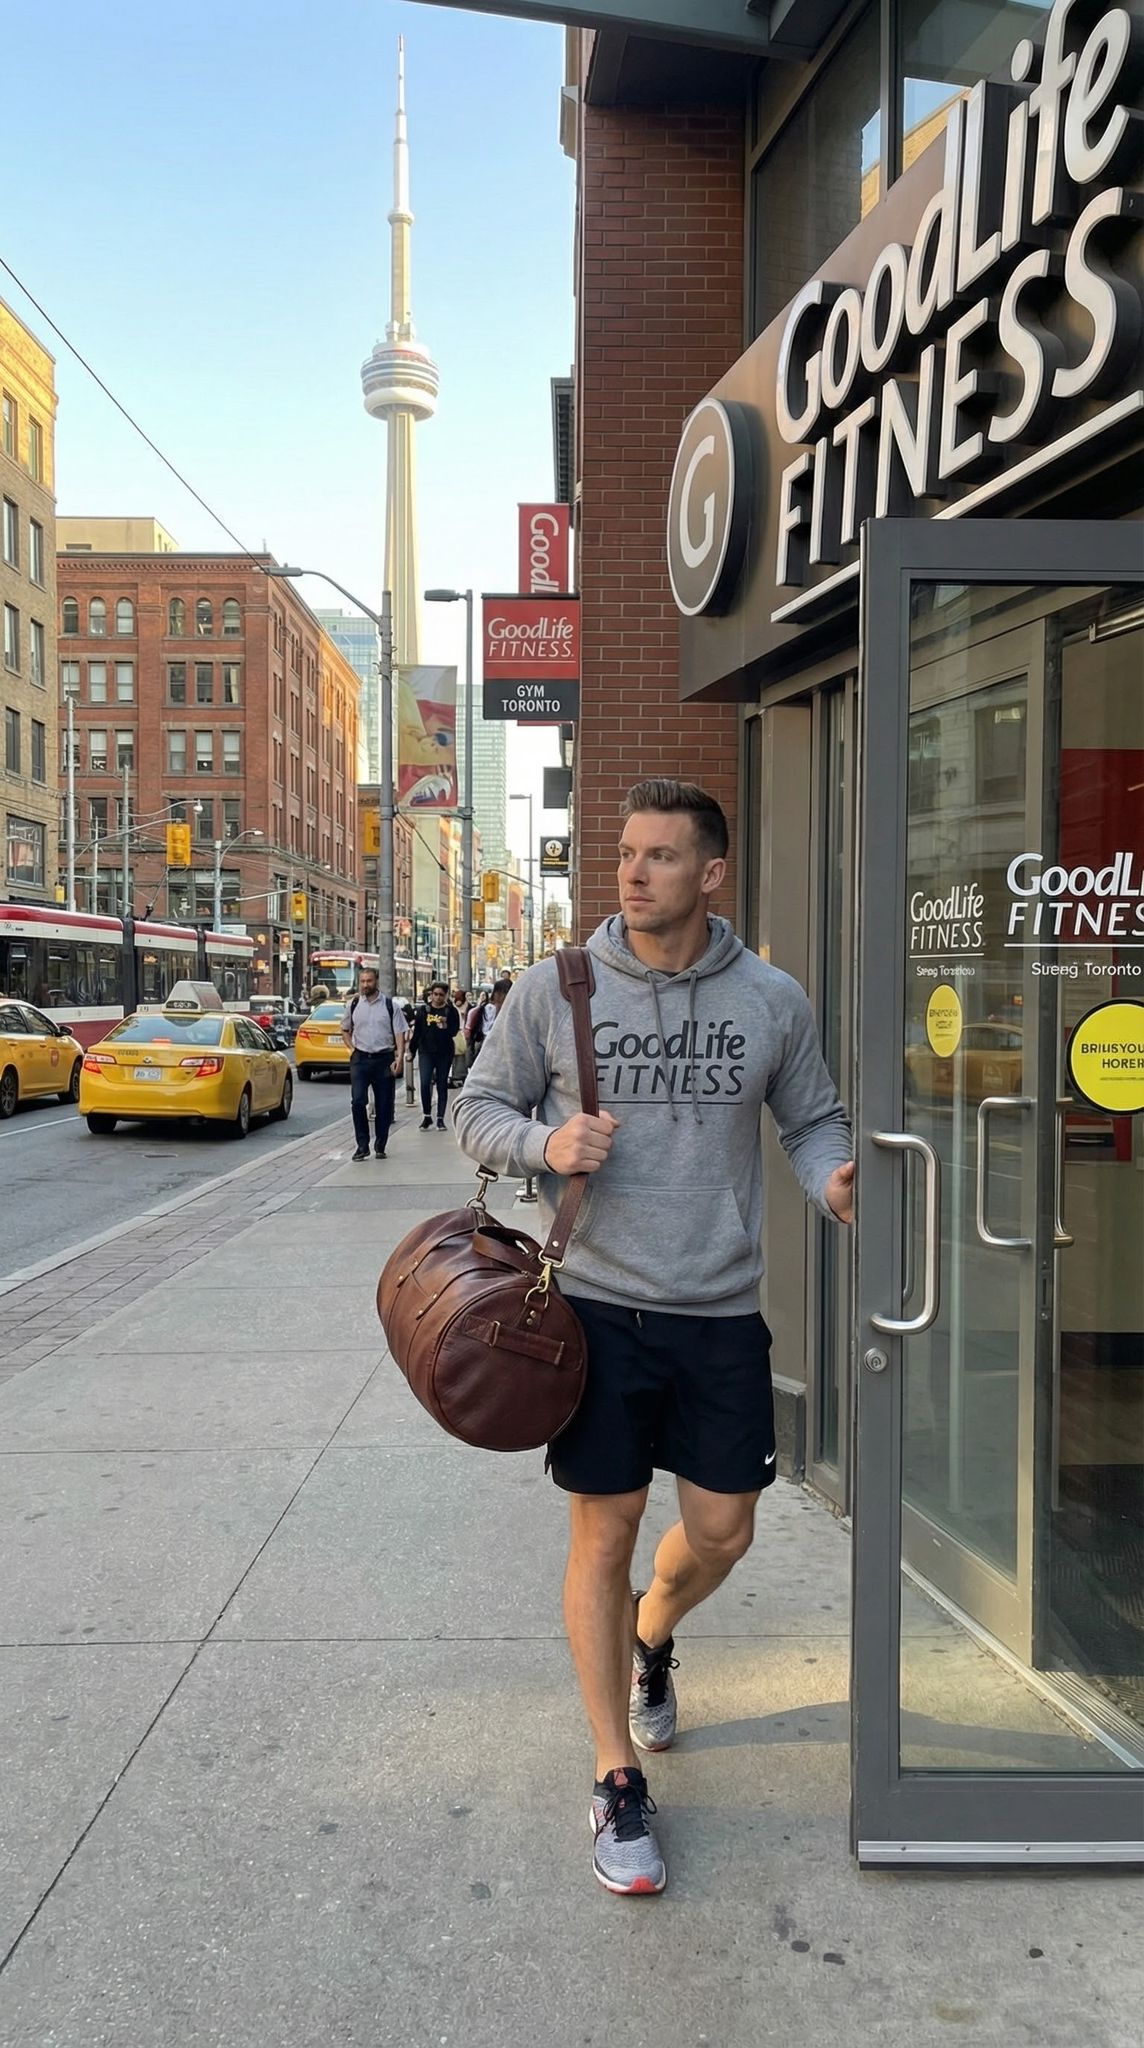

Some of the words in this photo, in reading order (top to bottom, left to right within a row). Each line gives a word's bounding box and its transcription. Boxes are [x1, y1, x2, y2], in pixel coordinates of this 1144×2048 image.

[776, 0, 1131, 444] GoodLife
[776, 187, 1123, 587] FITNESS
[488, 617, 574, 640] GoodLife
[501, 700, 560, 712] TORONTO
[517, 685, 545, 698] GYM
[910, 882, 984, 922] GoodLife
[911, 921, 983, 950] FITNESS
[1084, 962, 1142, 976] Toronto
[592, 1020, 746, 1060] GoodLife
